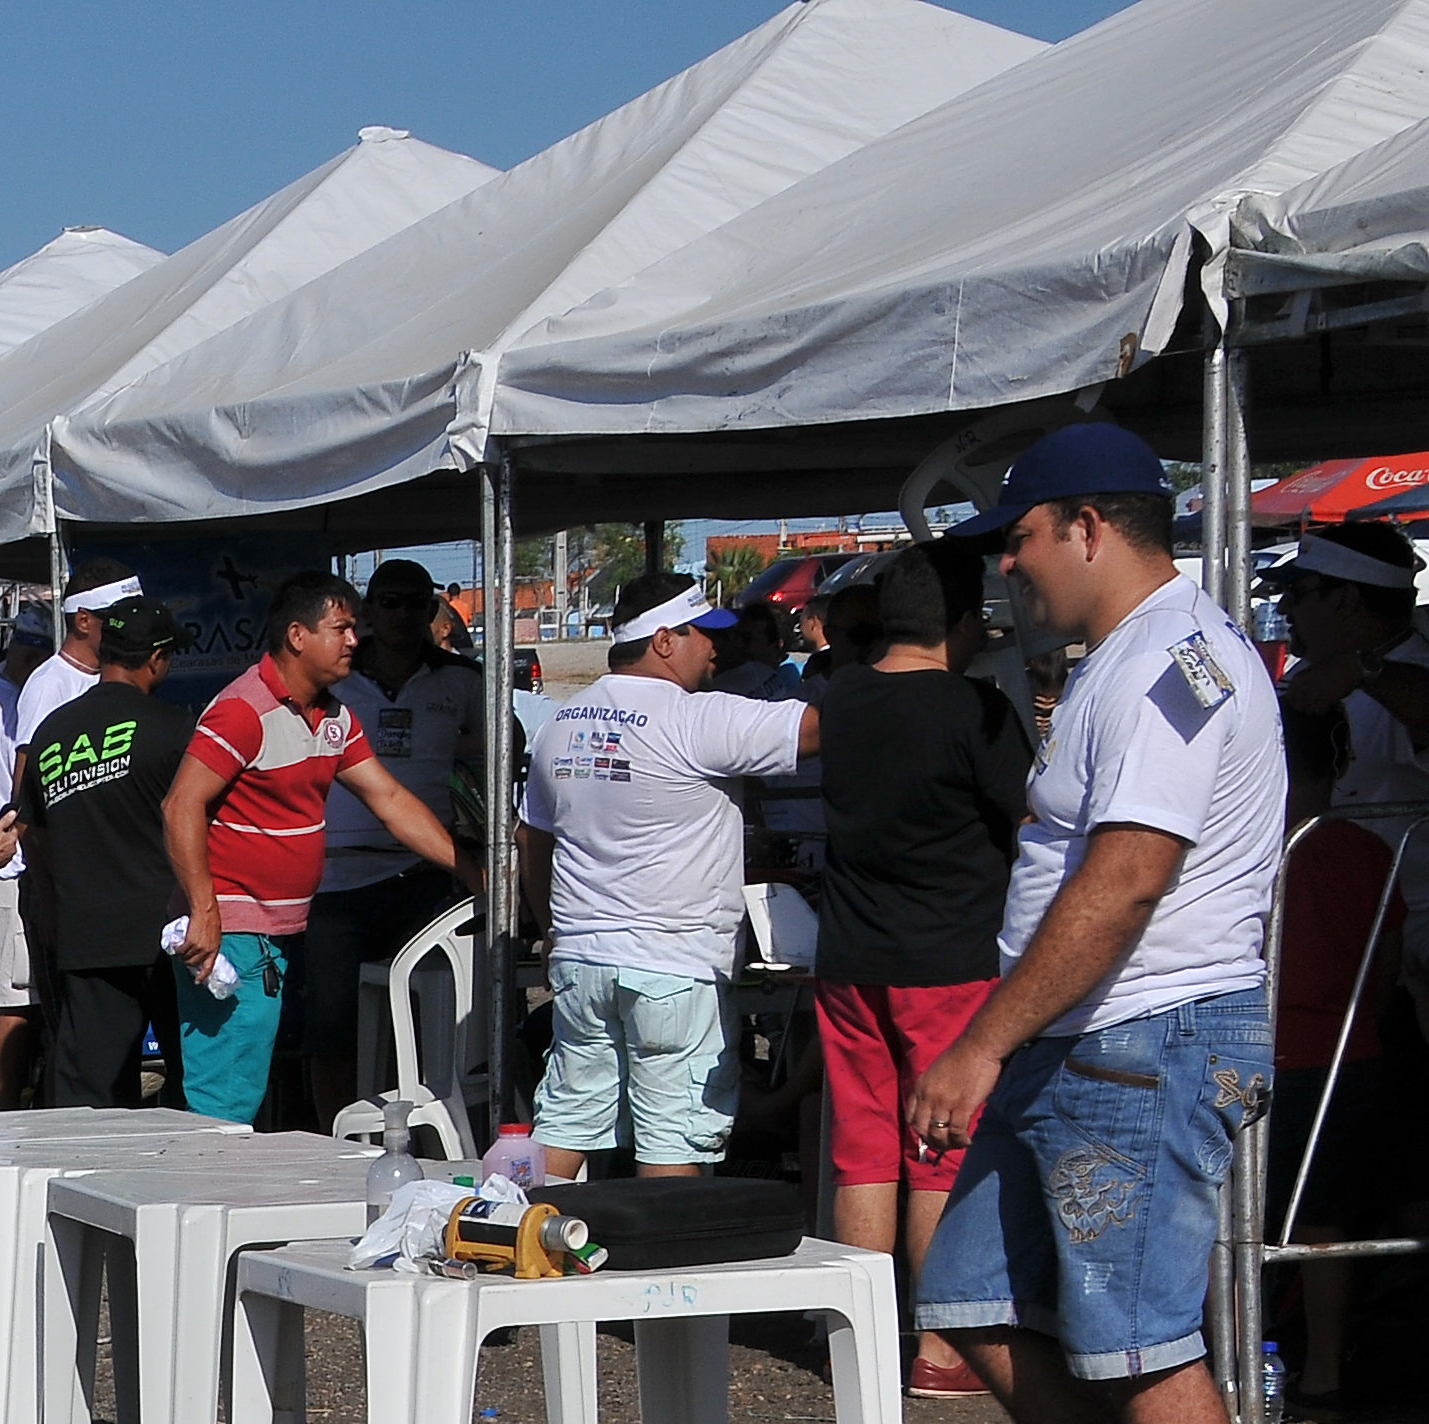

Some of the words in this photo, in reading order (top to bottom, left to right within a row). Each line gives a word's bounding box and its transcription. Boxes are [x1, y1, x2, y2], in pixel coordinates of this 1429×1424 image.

[555, 706, 649, 728] ORGANIZAÇÃO
[39, 720, 137, 786] SAB
[69, 754, 131, 786] DIVISION
